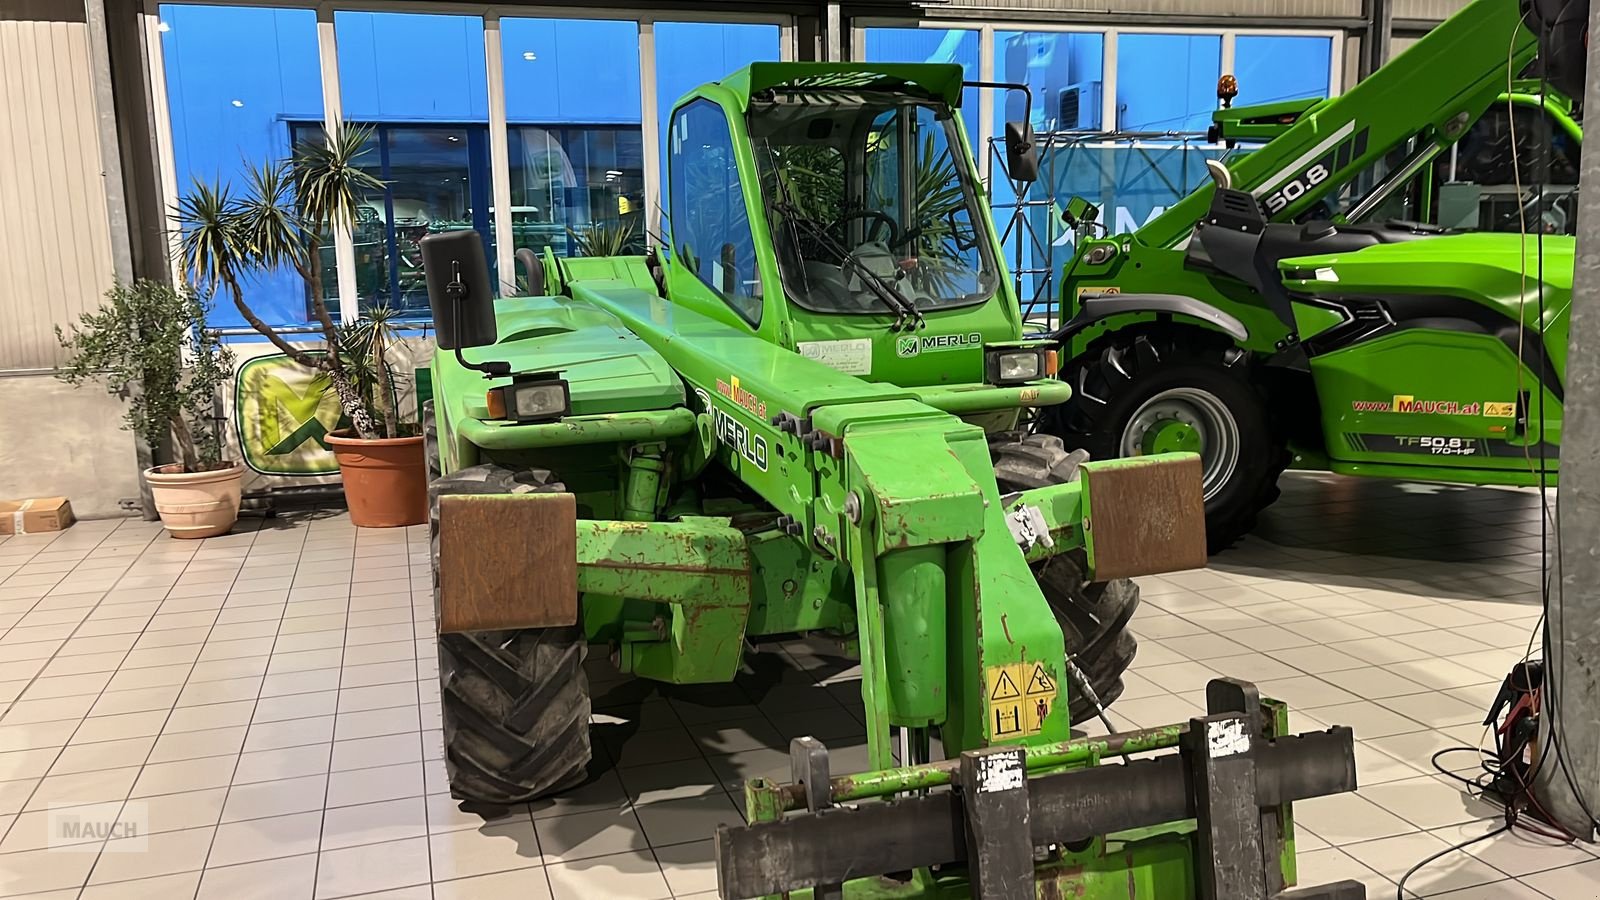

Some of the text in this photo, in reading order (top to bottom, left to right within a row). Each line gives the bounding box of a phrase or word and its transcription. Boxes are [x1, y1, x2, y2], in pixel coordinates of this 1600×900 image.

[1265, 163, 1329, 214] 50.8
[922, 333, 981, 347] MERLO
[716, 378, 767, 421] www.MAUCHat
[713, 406, 768, 472] MERLO
[1395, 436, 1476, 448] TF50.8T
[1431, 447, 1476, 455] 170-HF
